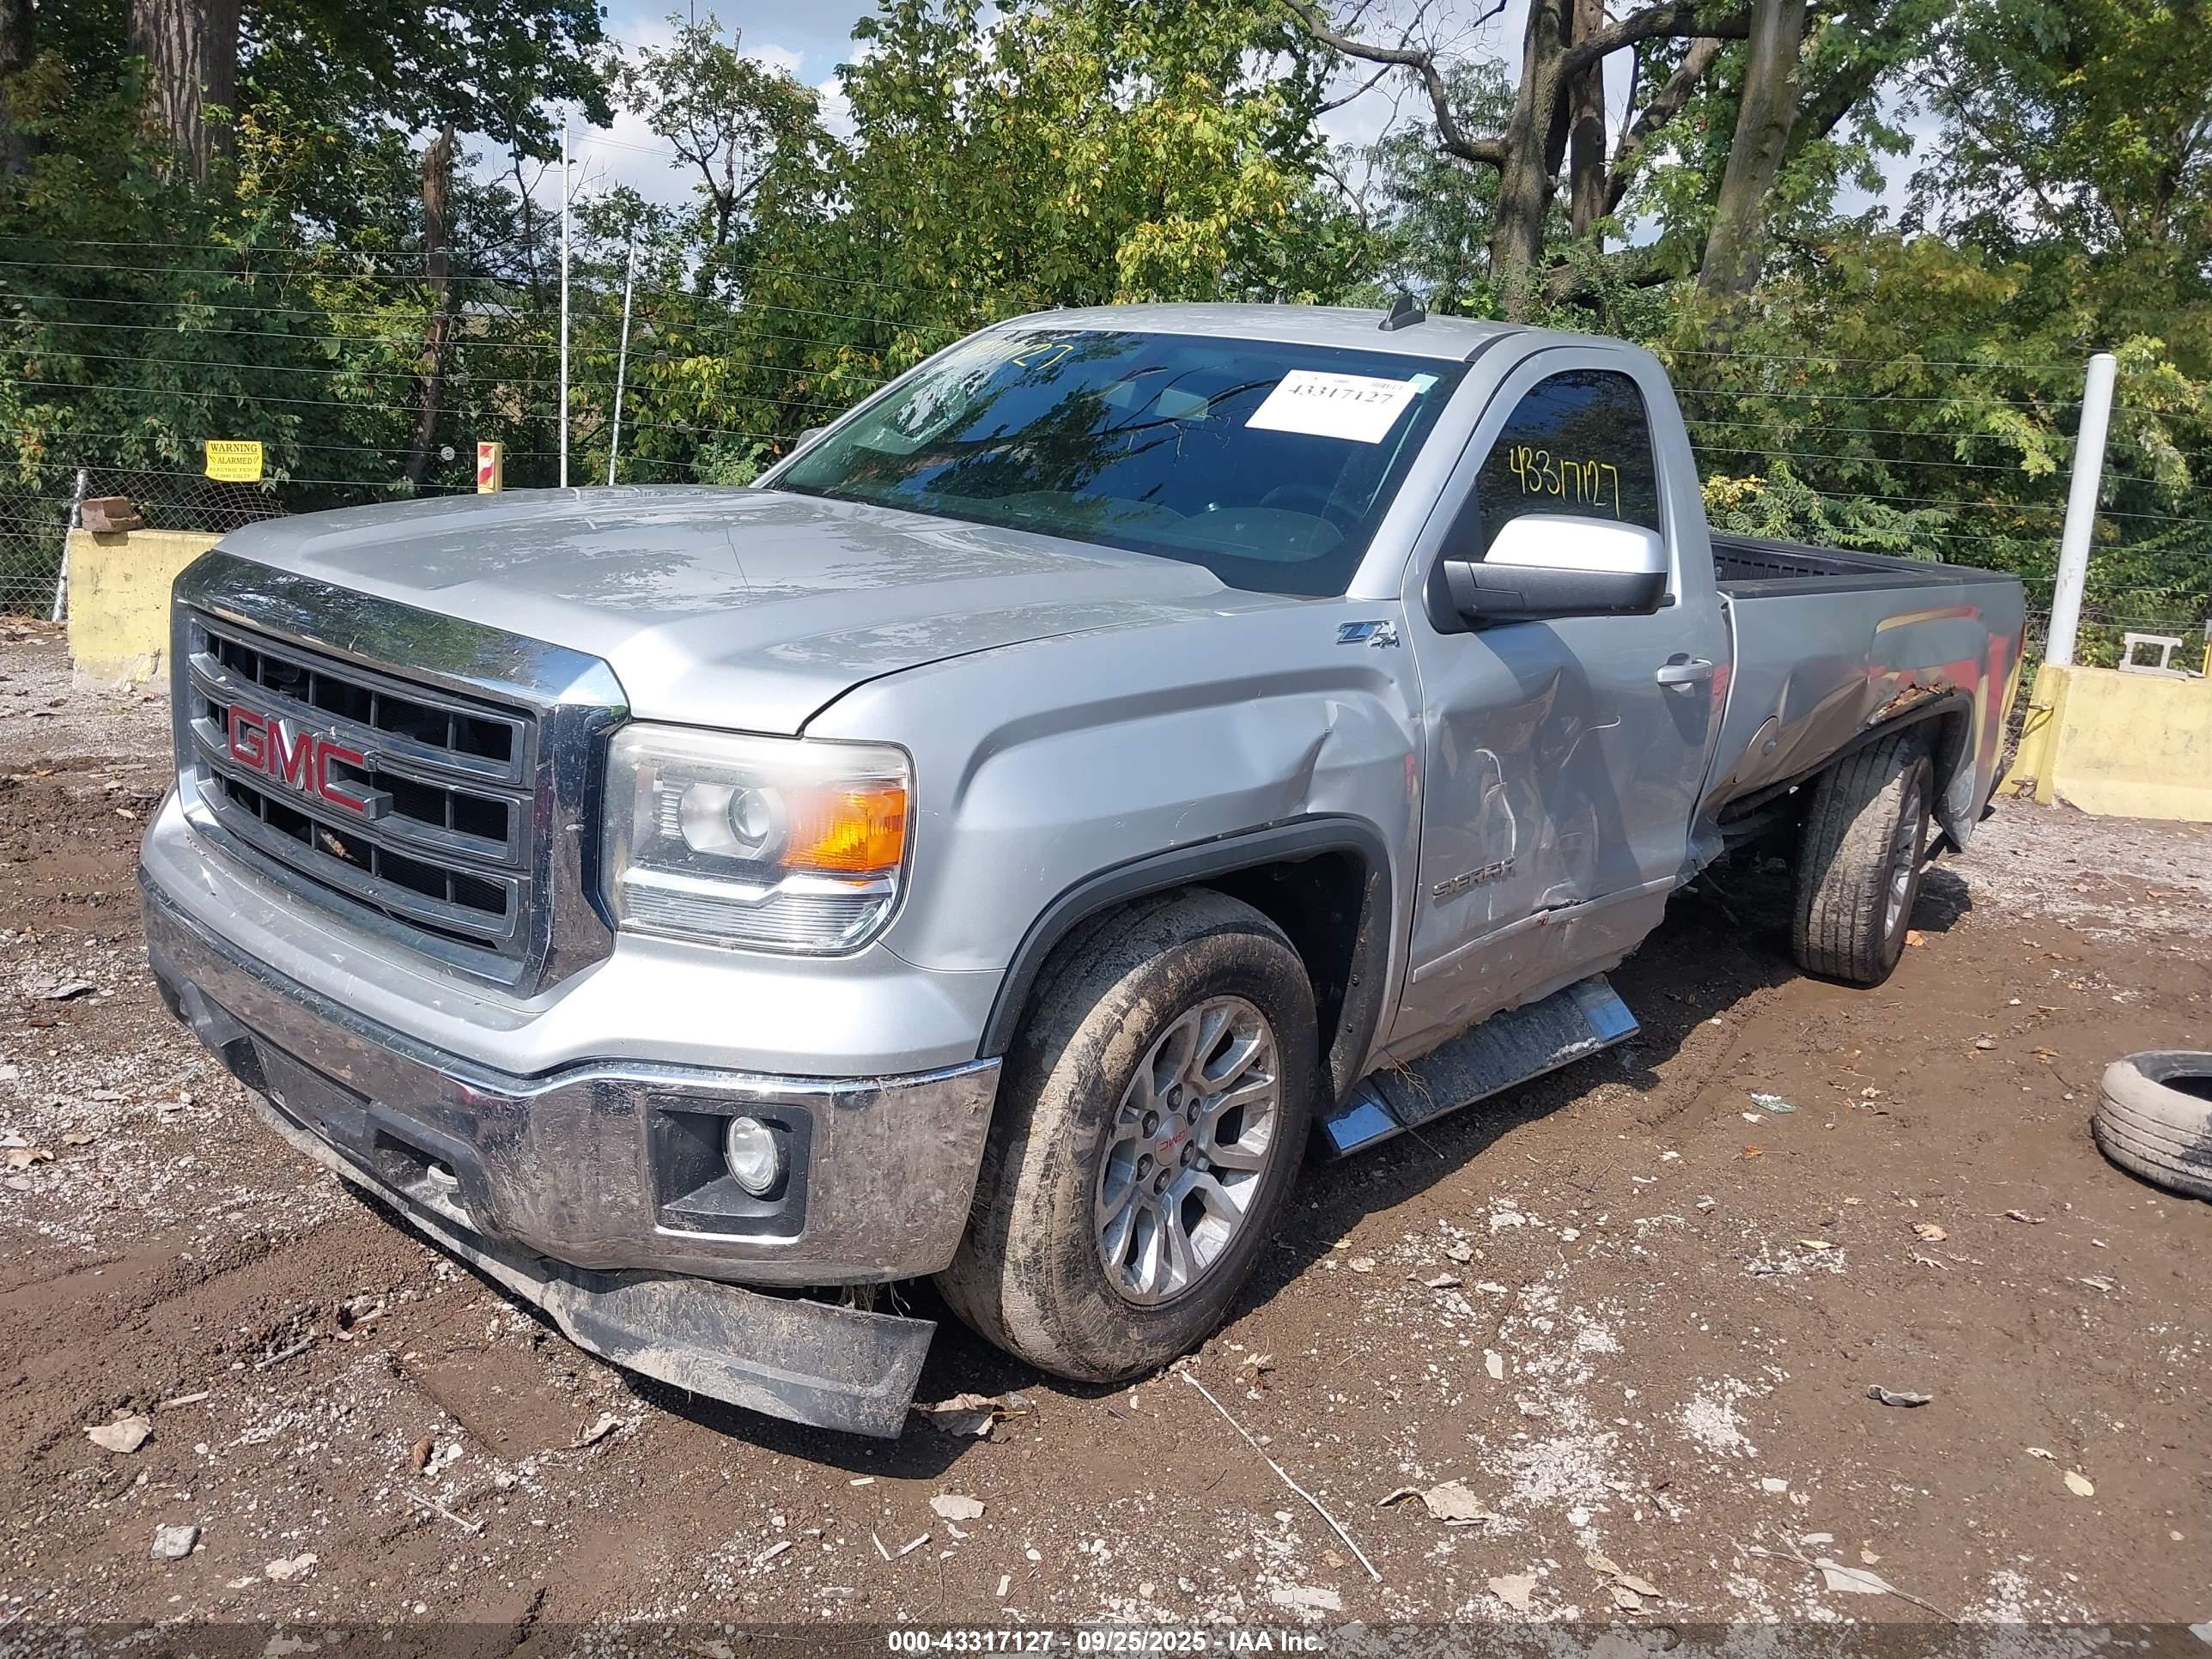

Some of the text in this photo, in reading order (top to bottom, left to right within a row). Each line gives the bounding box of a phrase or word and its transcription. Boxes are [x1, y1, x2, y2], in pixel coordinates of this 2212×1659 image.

[1288, 384, 1395, 404] 43317127
[210, 443, 258, 453] WARNING
[1510, 445, 1620, 520] 43317127
[228, 702, 380, 818] GMC
[1432, 858, 1515, 898] SIERRA
[1159, 1130, 1186, 1152] GMC
